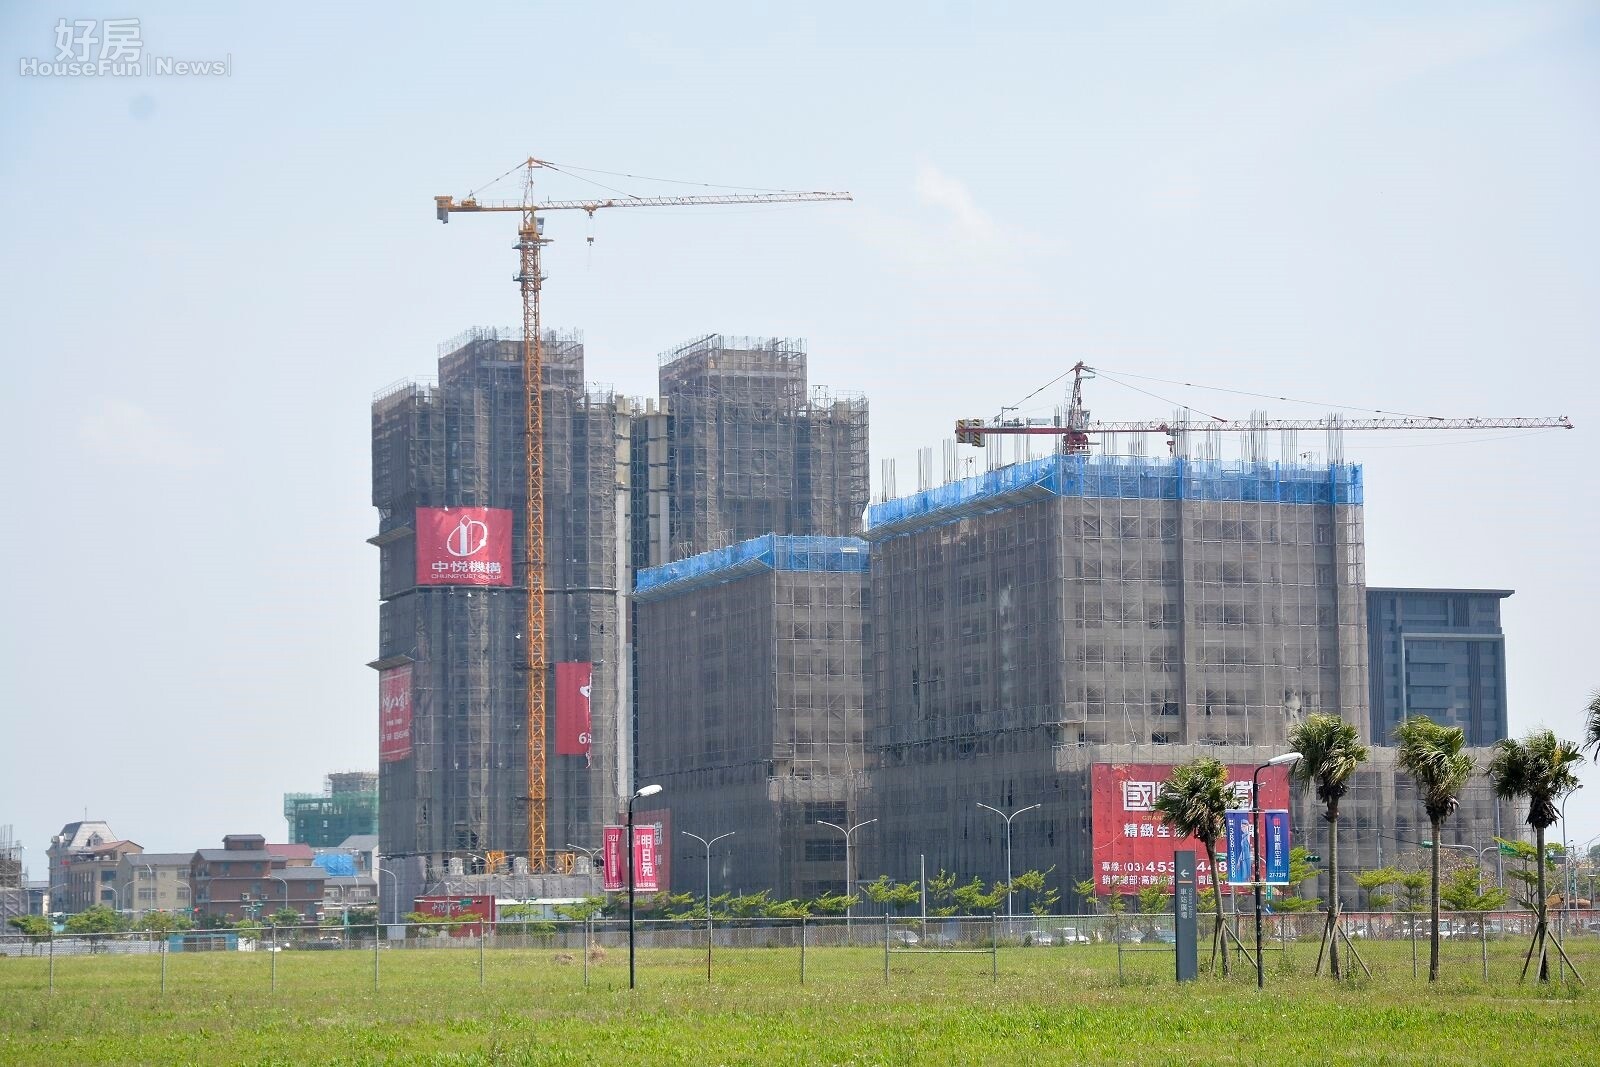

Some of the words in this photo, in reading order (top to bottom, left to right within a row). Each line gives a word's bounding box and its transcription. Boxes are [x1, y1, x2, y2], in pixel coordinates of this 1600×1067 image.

[431, 560, 501, 574] 中悅機構
[641, 834, 653, 877] 明日苑
